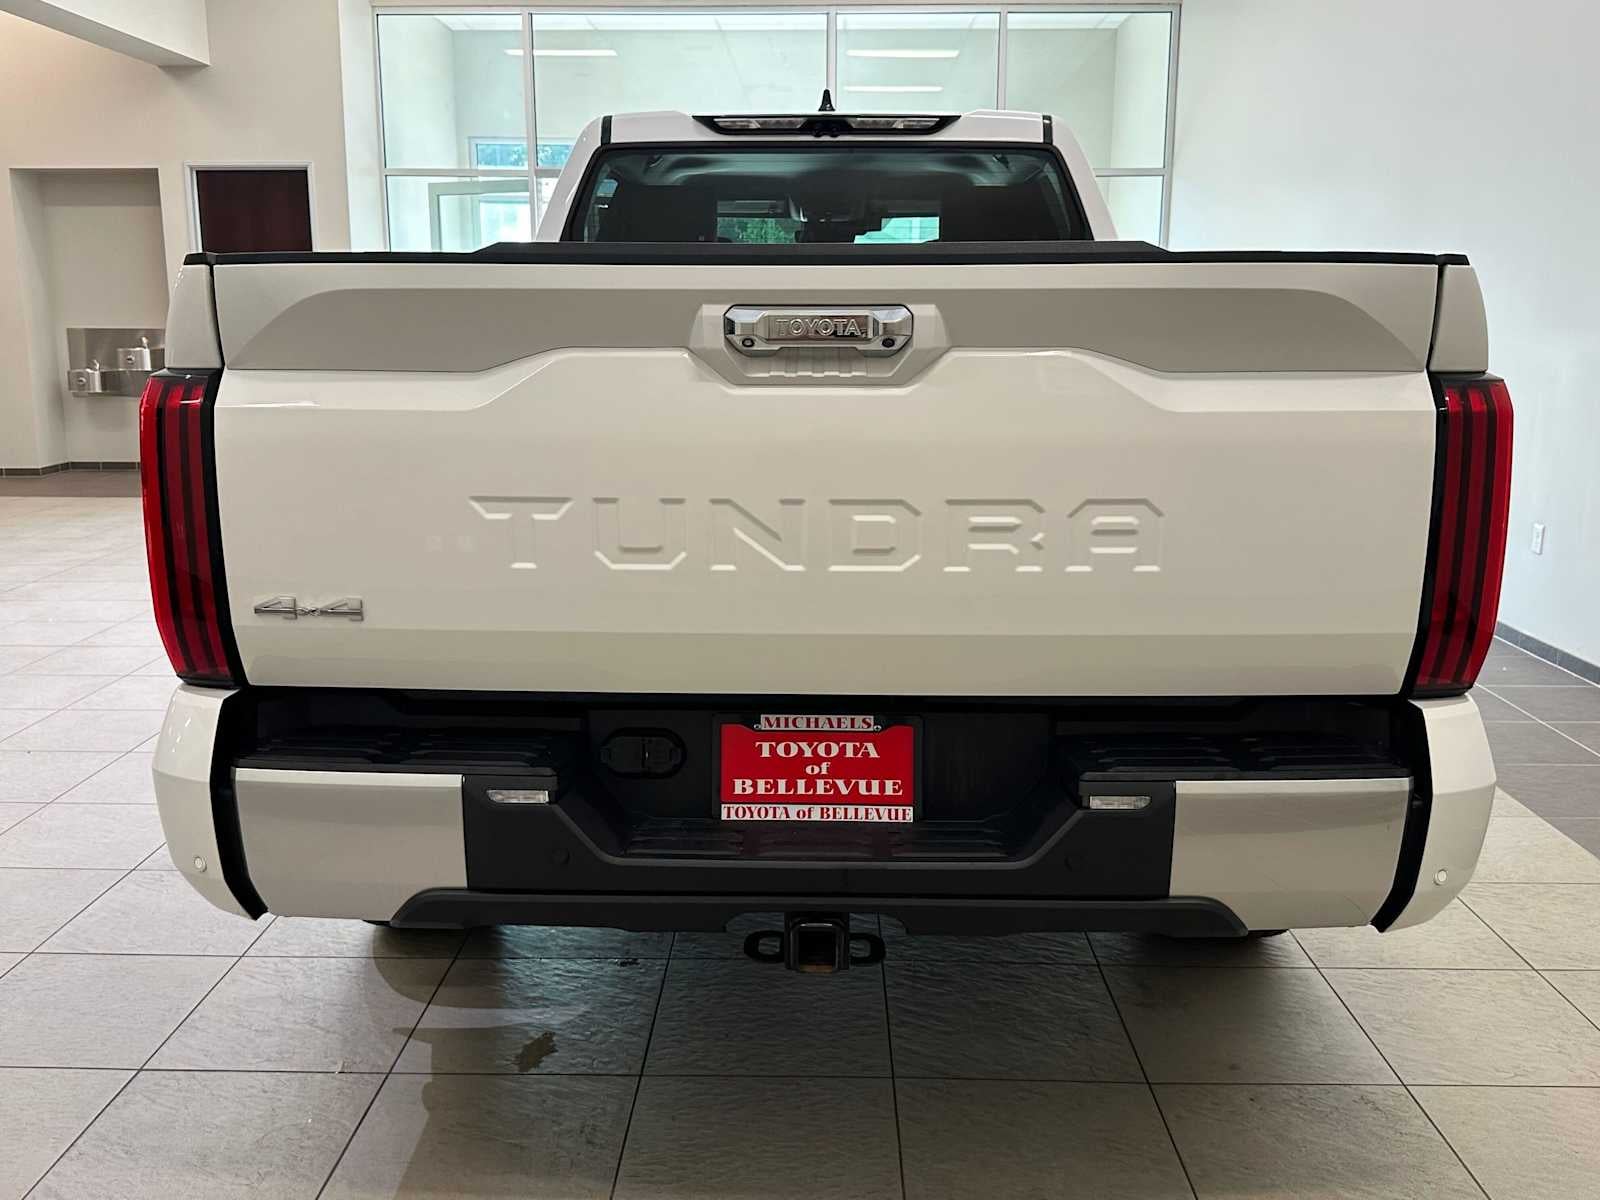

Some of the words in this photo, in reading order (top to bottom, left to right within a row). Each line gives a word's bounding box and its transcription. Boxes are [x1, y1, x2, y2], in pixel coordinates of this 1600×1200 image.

[776, 319, 861, 337] TOYOTA
[468, 495, 1165, 573] TUNDRA
[763, 716, 873, 729] MICHAELS
[756, 741, 880, 758] TOYOTA
[805, 762, 831, 775] of
[732, 778, 903, 796] BELLEVUE
[724, 806, 790, 819] TOYOTA
[796, 806, 815, 820] of
[819, 807, 912, 822] BELLEVUE
